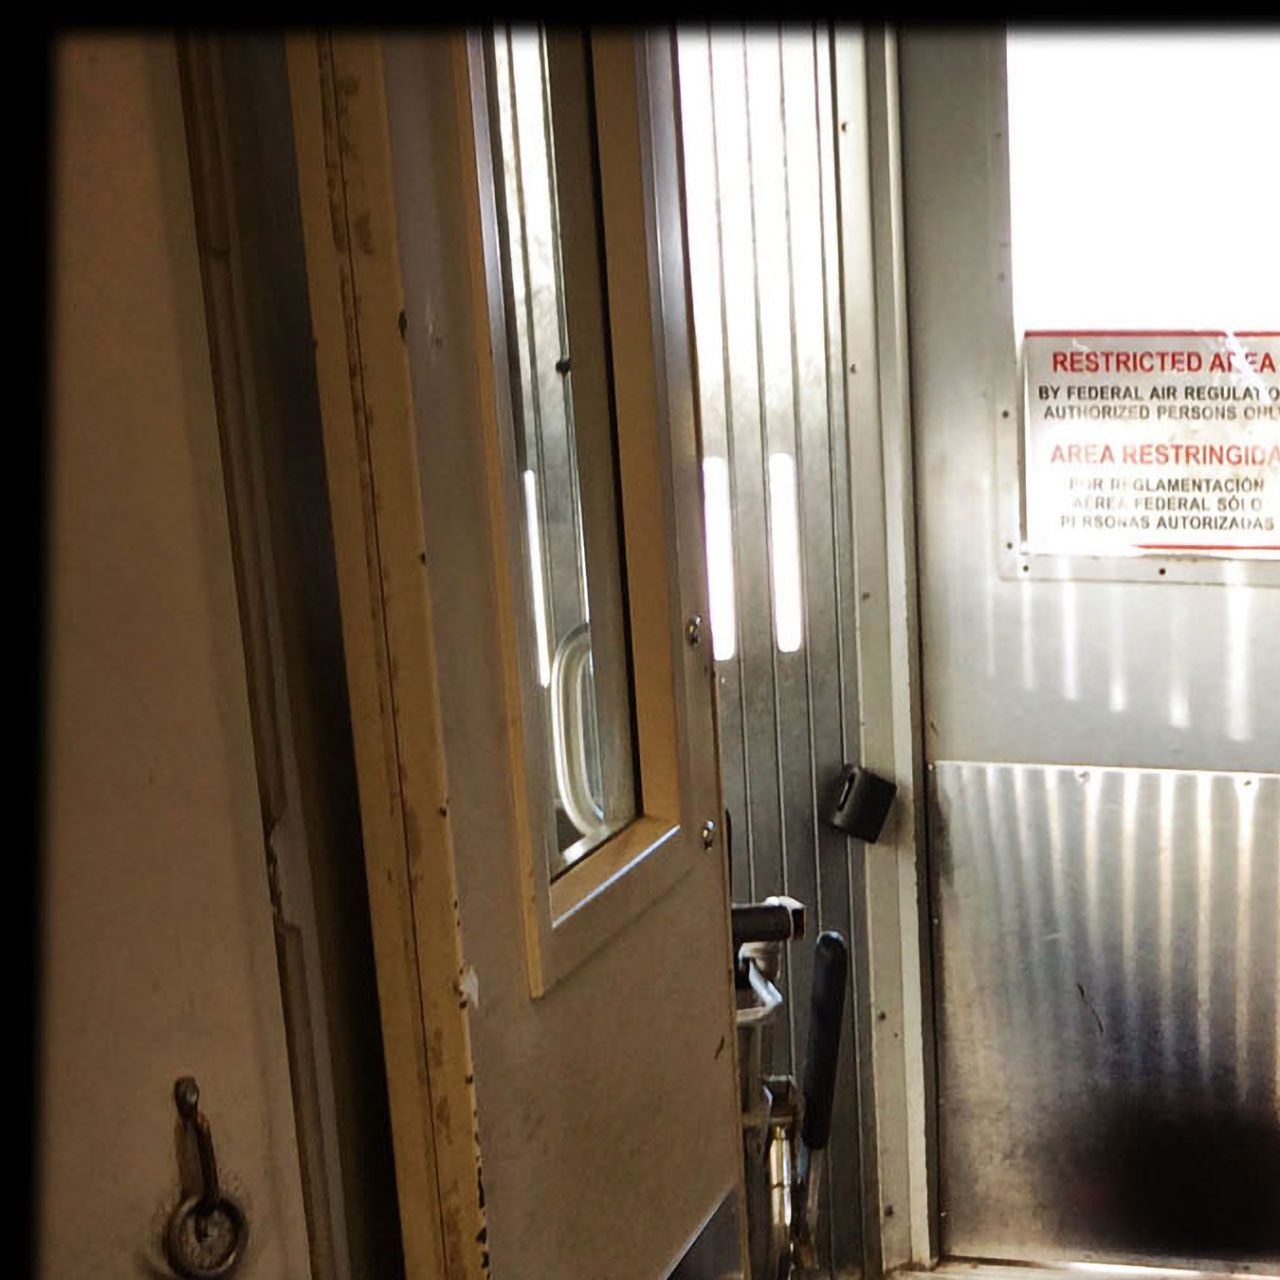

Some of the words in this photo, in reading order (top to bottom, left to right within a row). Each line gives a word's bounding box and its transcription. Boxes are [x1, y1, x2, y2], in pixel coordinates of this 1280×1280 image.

[1052, 351, 1201, 373] RESTRICTED
[1038, 385, 1061, 401] BY
[1067, 385, 1144, 401] FEDERAL
[1150, 386, 1178, 401] AIR
[1044, 404, 1151, 420] AUTHORIZED
[1157, 405, 1237, 420] PERSONS
[1050, 444, 1115, 466] AREA
[1156, 515, 1275, 531] AUTORIZADAS
